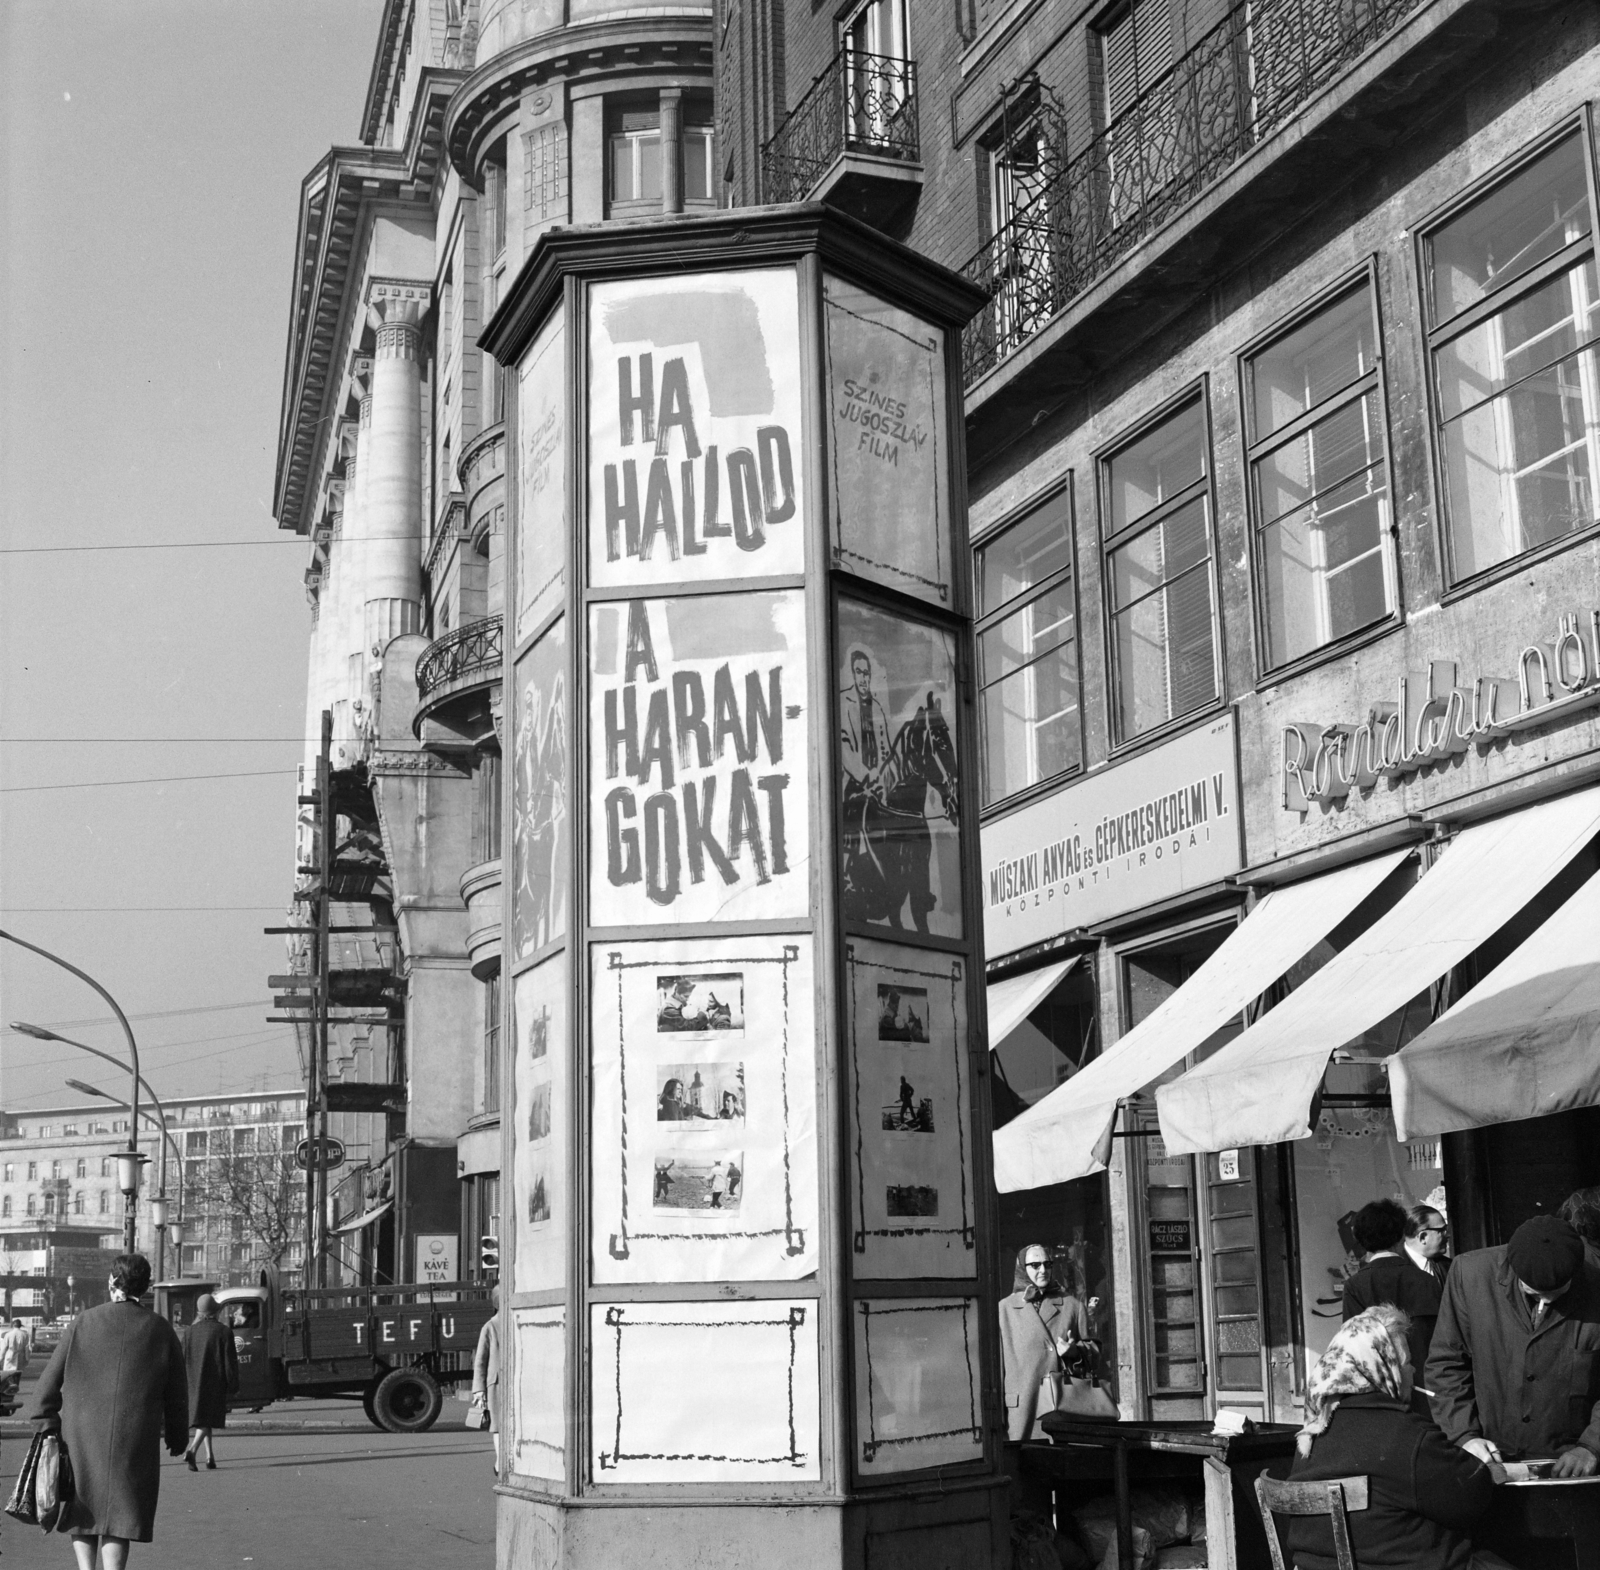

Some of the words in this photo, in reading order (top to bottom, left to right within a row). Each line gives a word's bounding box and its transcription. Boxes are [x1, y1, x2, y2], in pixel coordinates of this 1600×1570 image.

[618, 352, 702, 459] HA
[604, 425, 796, 562] HALLOD
[625, 600, 660, 683] A
[604, 662, 803, 790] HARAN-
[604, 766, 791, 906] GOKAT
[990, 852, 1038, 906] MŰSZAKI
[1043, 834, 1081, 886] ANYAG
[1095, 779, 1208, 864] GÉPKERESKEDELMI
[1213, 773, 1228, 816] V.
[1006, 870, 1110, 917] KÖZPONTI
[1127, 827, 1211, 872] IRODÁI
[1223, 1162, 1235, 1175] 25
[427, 1272, 446, 1280] TEA
[353, 1318, 454, 1344] TEFU
